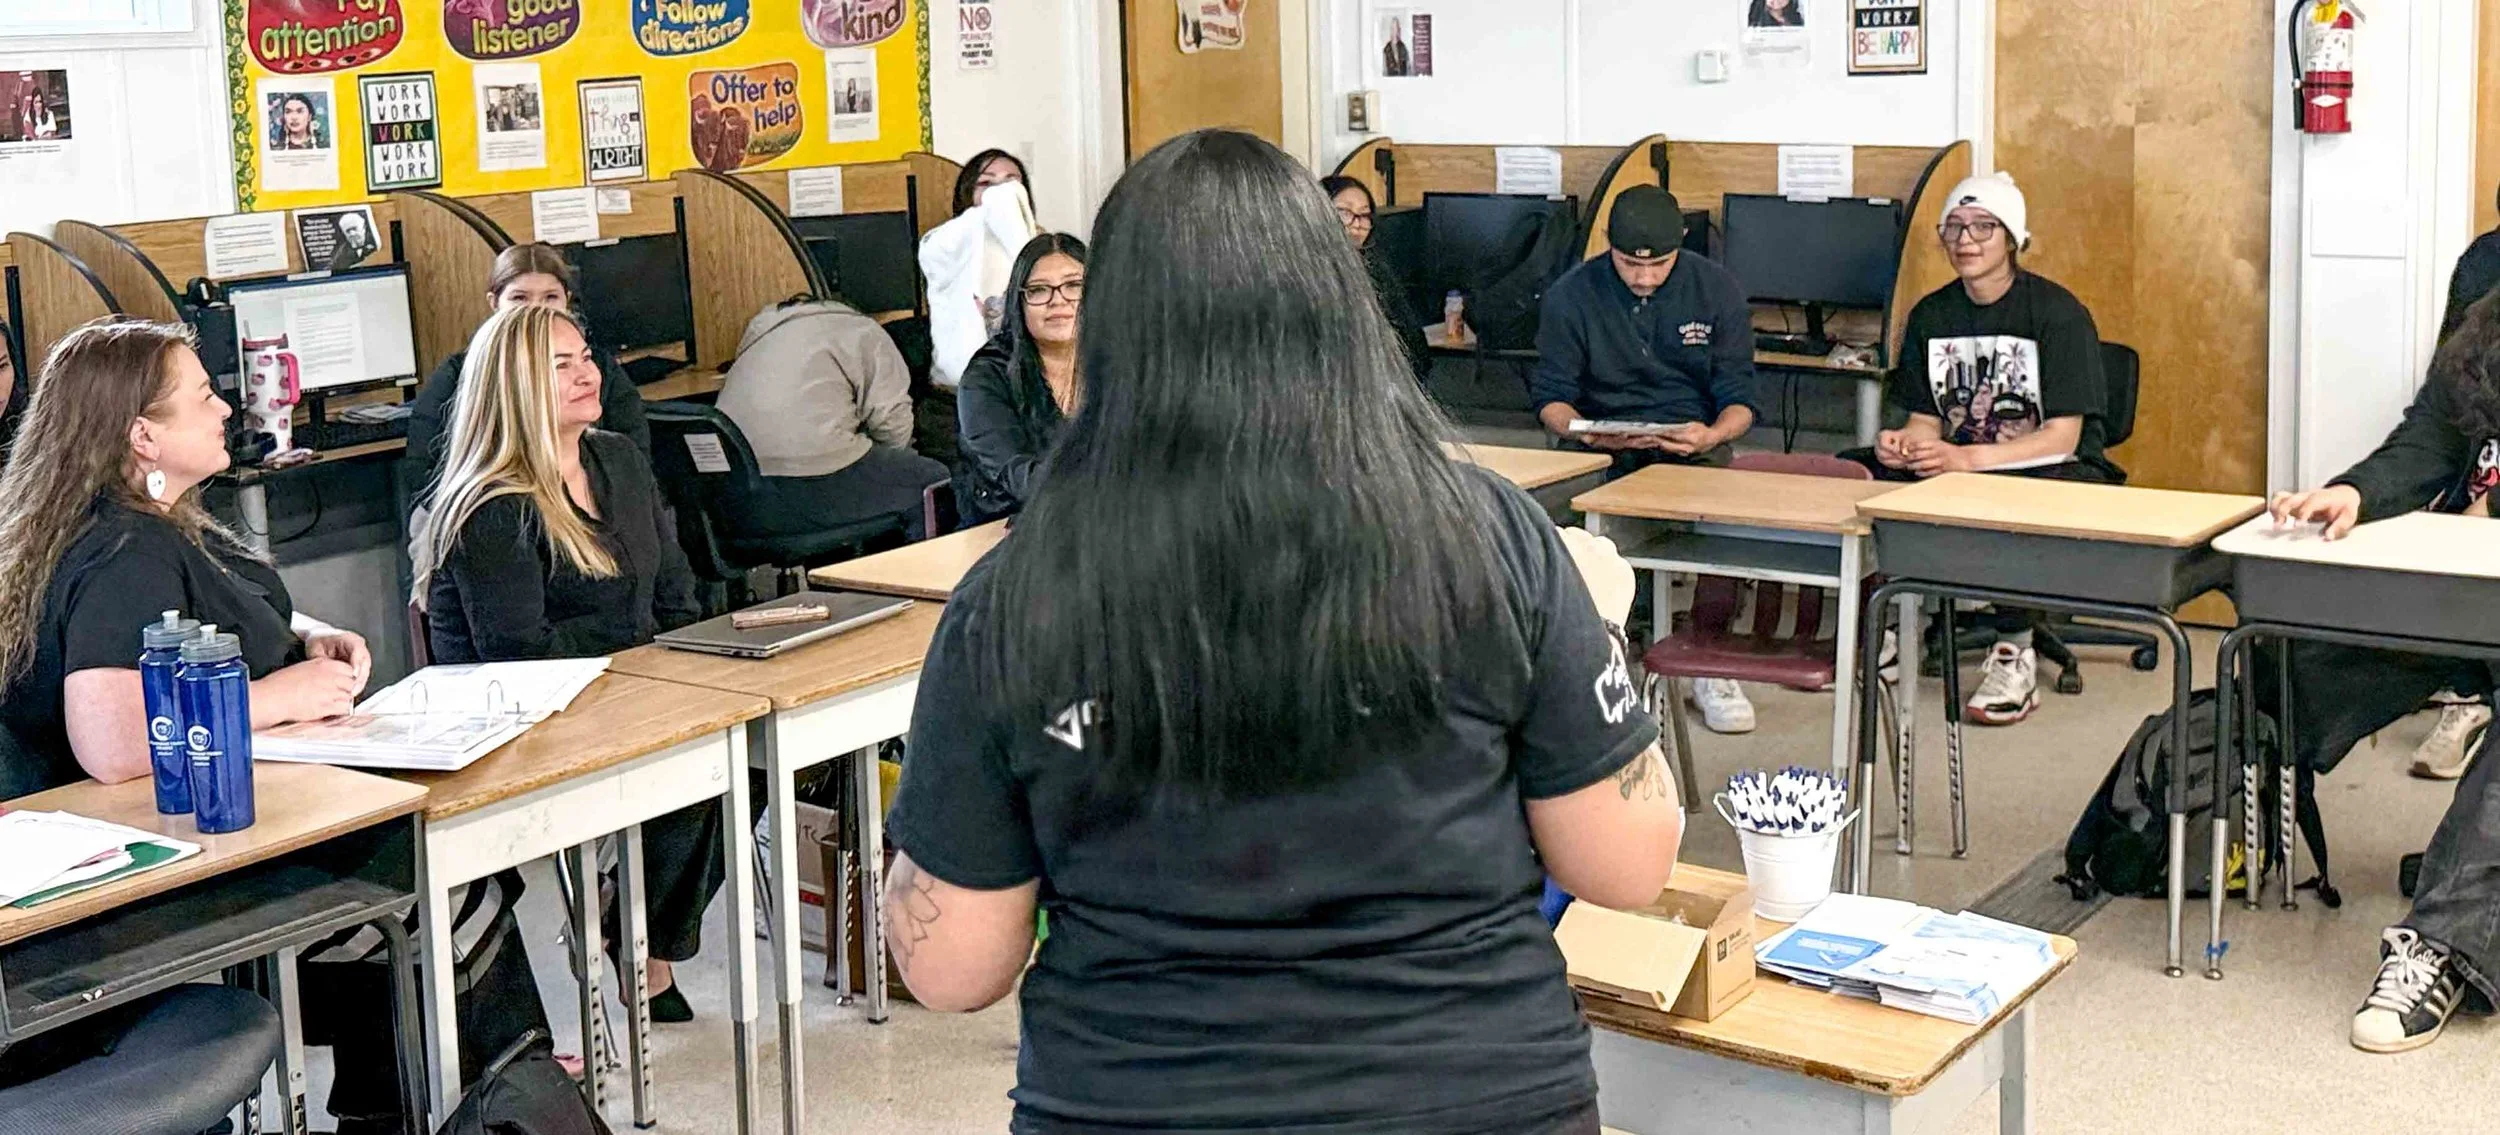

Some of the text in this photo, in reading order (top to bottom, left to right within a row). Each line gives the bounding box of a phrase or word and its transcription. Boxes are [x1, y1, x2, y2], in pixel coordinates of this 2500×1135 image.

[655, 0, 727, 24] Follow
[841, 0, 901, 41] kind
[959, 6, 992, 31] NO
[1861, 11, 1913, 26] WORRY
[260, 16, 396, 61] attention
[472, 17, 571, 54] listener
[640, 16, 744, 52] directions
[375, 84, 422, 102] WORK
[711, 73, 794, 104] Offer to
[377, 103, 423, 121] WORK
[754, 100, 797, 133] help
[378, 122, 426, 142] WORK
[381, 143, 427, 161] WORK
[592, 146, 641, 169] ALRIGHT
[382, 162, 428, 181] WORK
